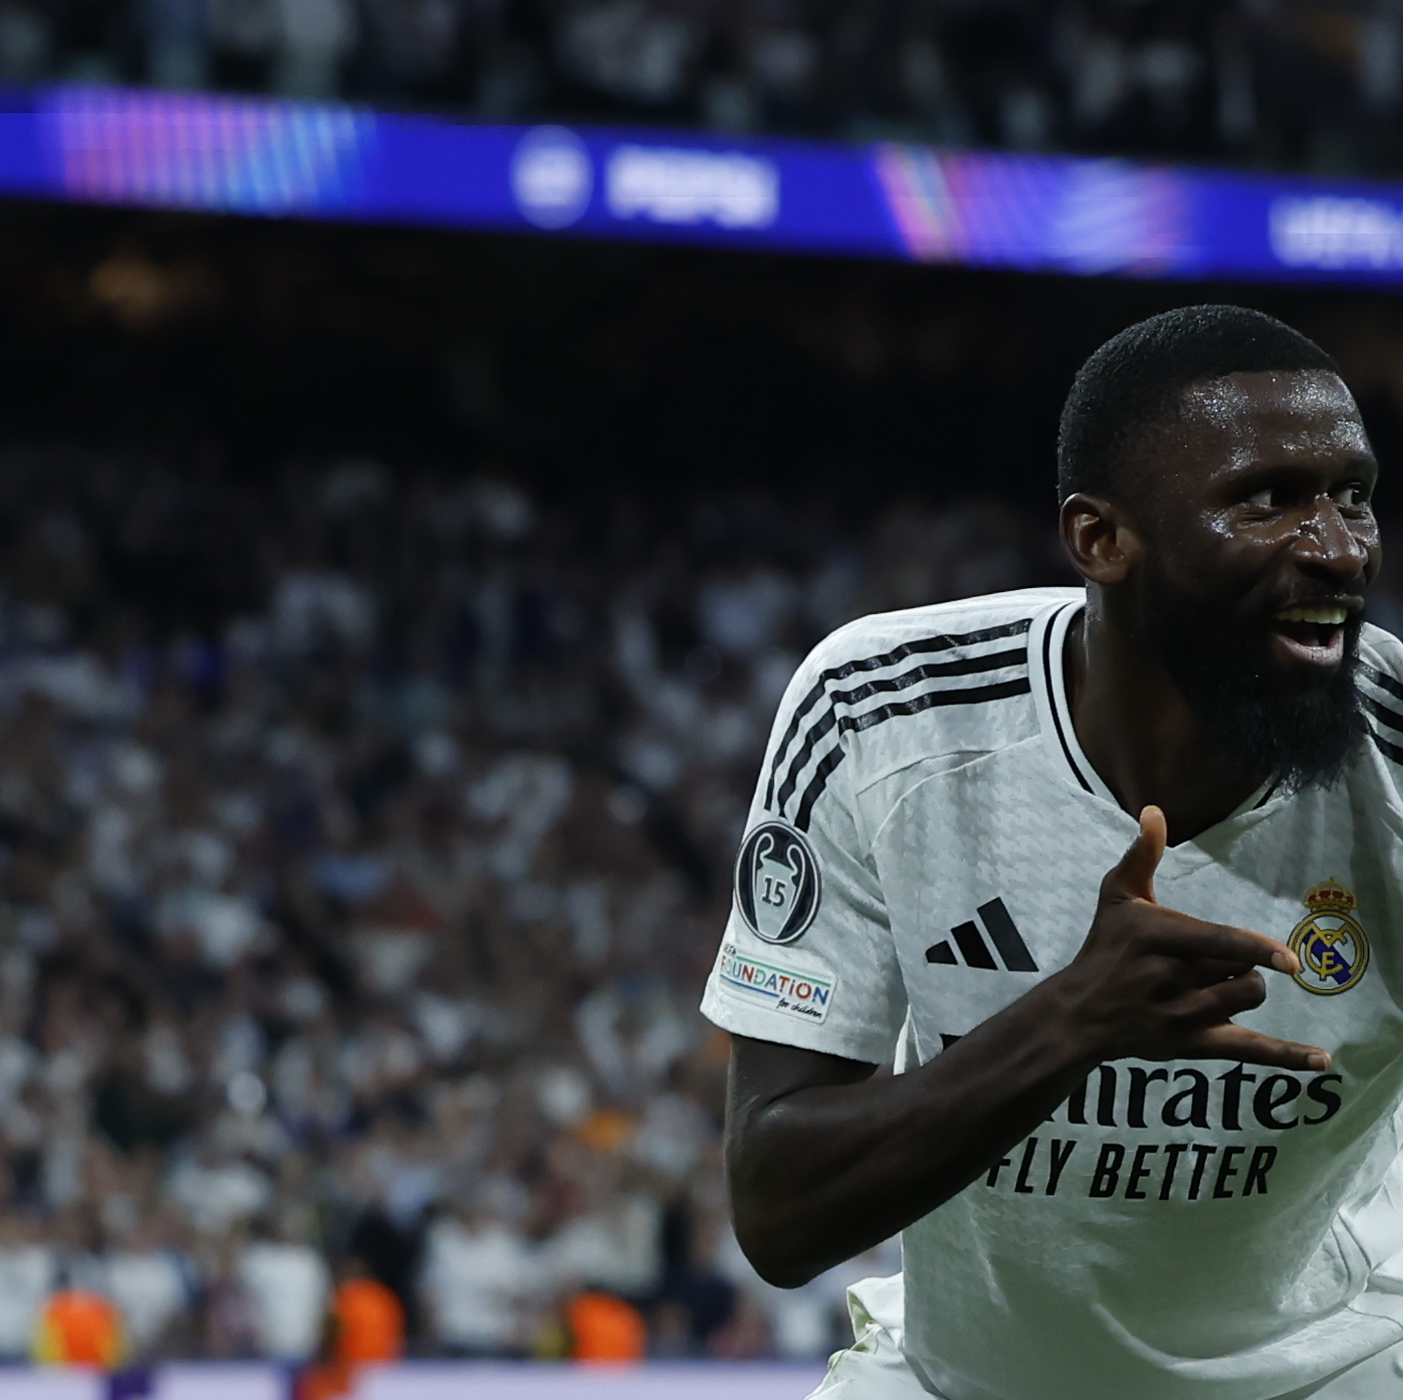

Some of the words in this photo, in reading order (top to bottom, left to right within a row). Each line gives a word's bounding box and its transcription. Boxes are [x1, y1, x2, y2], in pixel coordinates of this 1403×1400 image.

[761, 876, 786, 907] 15
[790, 1002, 823, 1019] children
[1042, 1058, 1343, 1131] irates
[1089, 1142, 1278, 1200] BETTER
